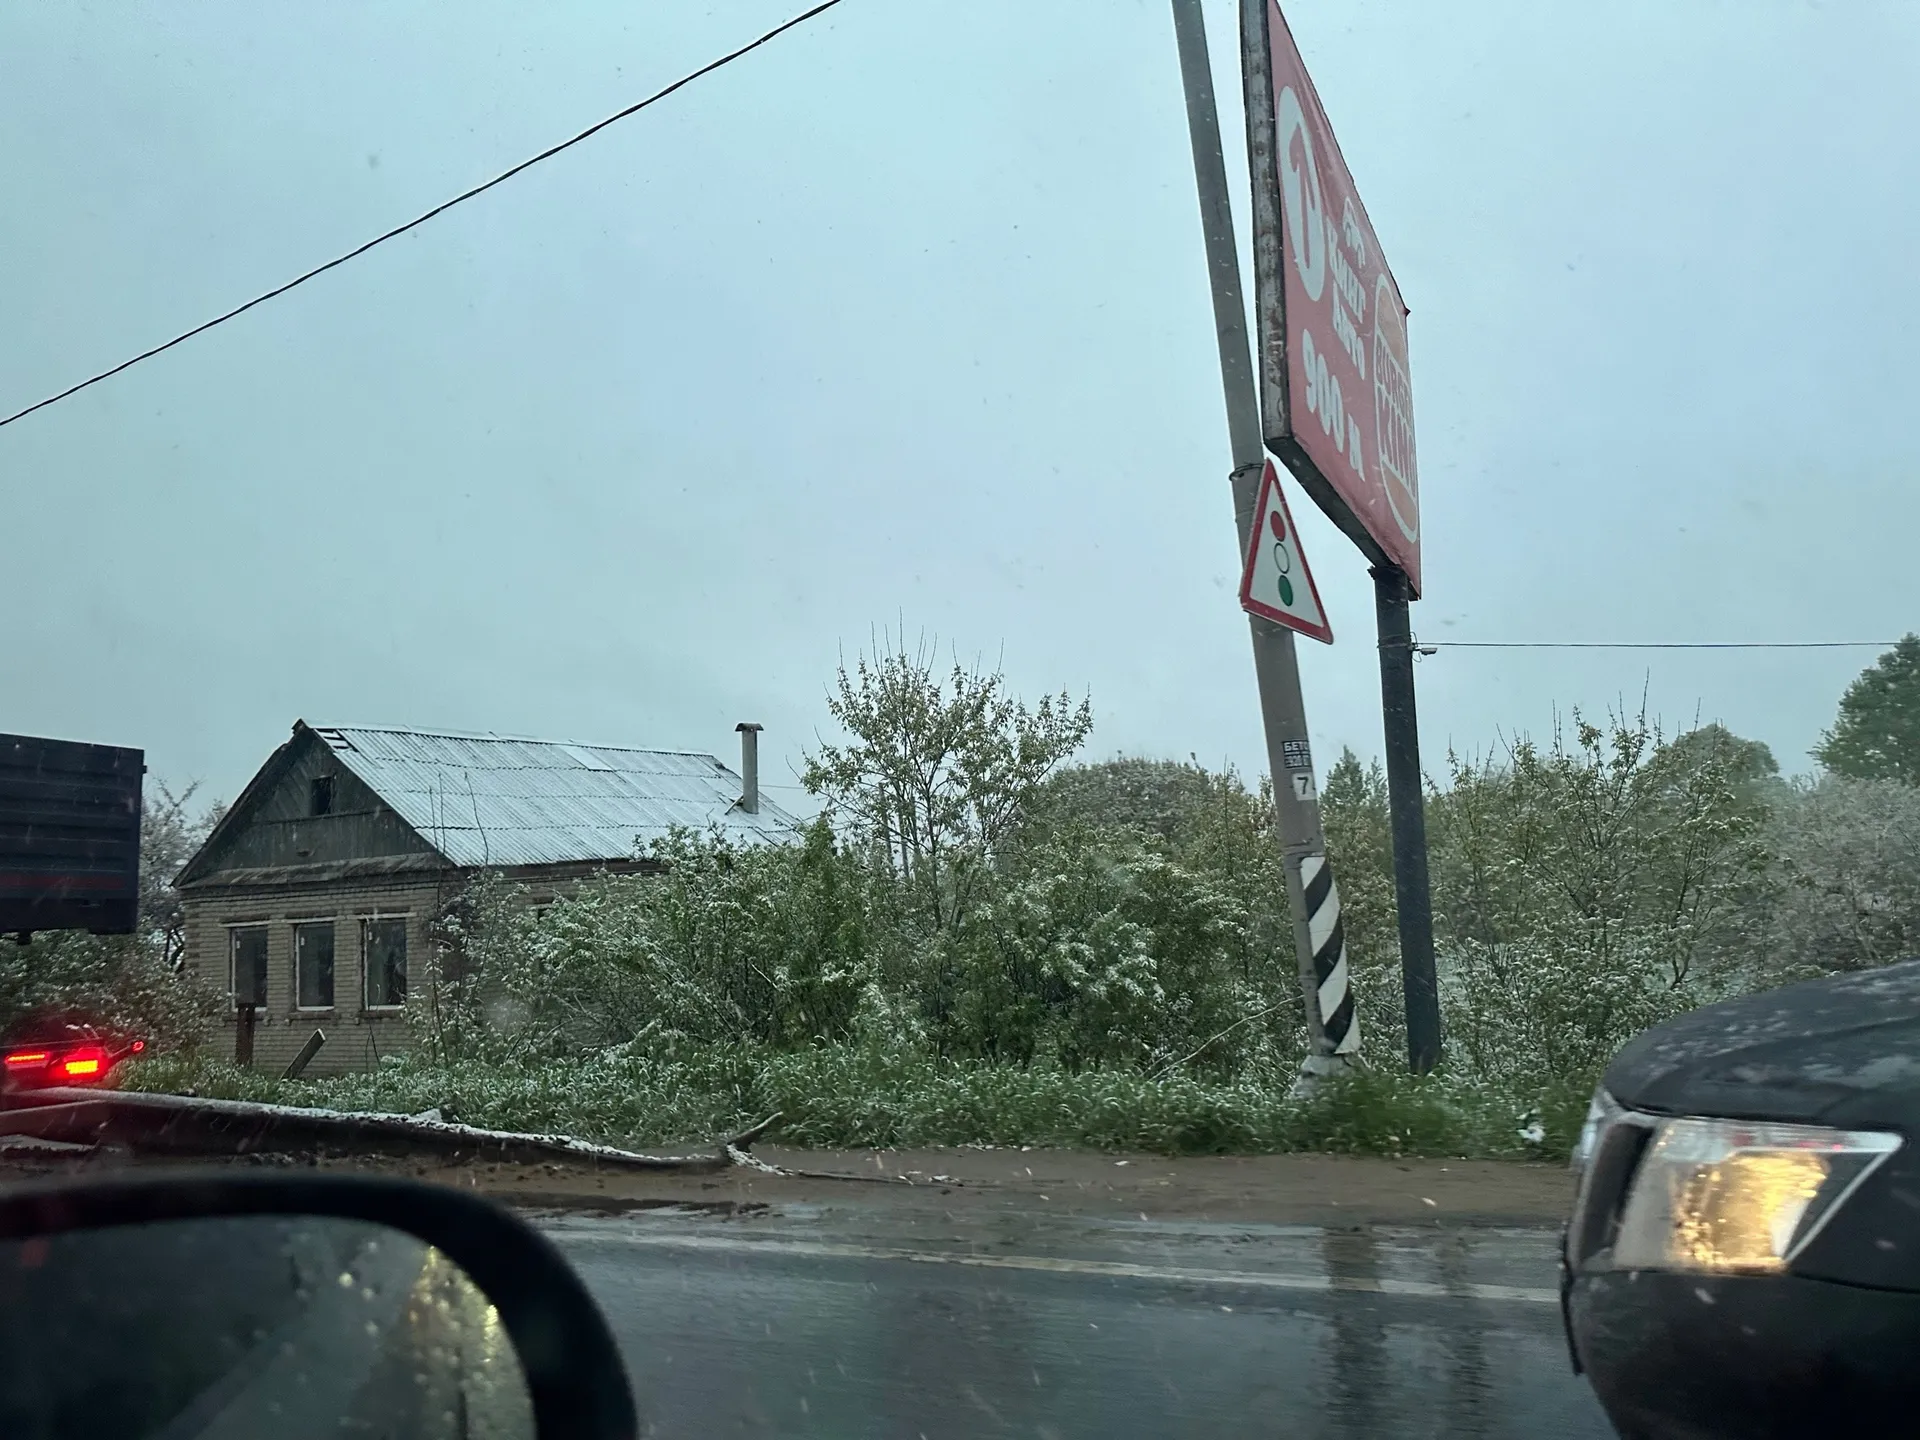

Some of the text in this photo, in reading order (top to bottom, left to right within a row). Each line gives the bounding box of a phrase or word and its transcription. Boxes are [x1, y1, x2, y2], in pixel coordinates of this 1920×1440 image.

[1332, 279, 1366, 381] Авто
[1302, 328, 1344, 453] 900
[1377, 385, 1417, 498] KING
[1297, 776, 1309, 795] 7
